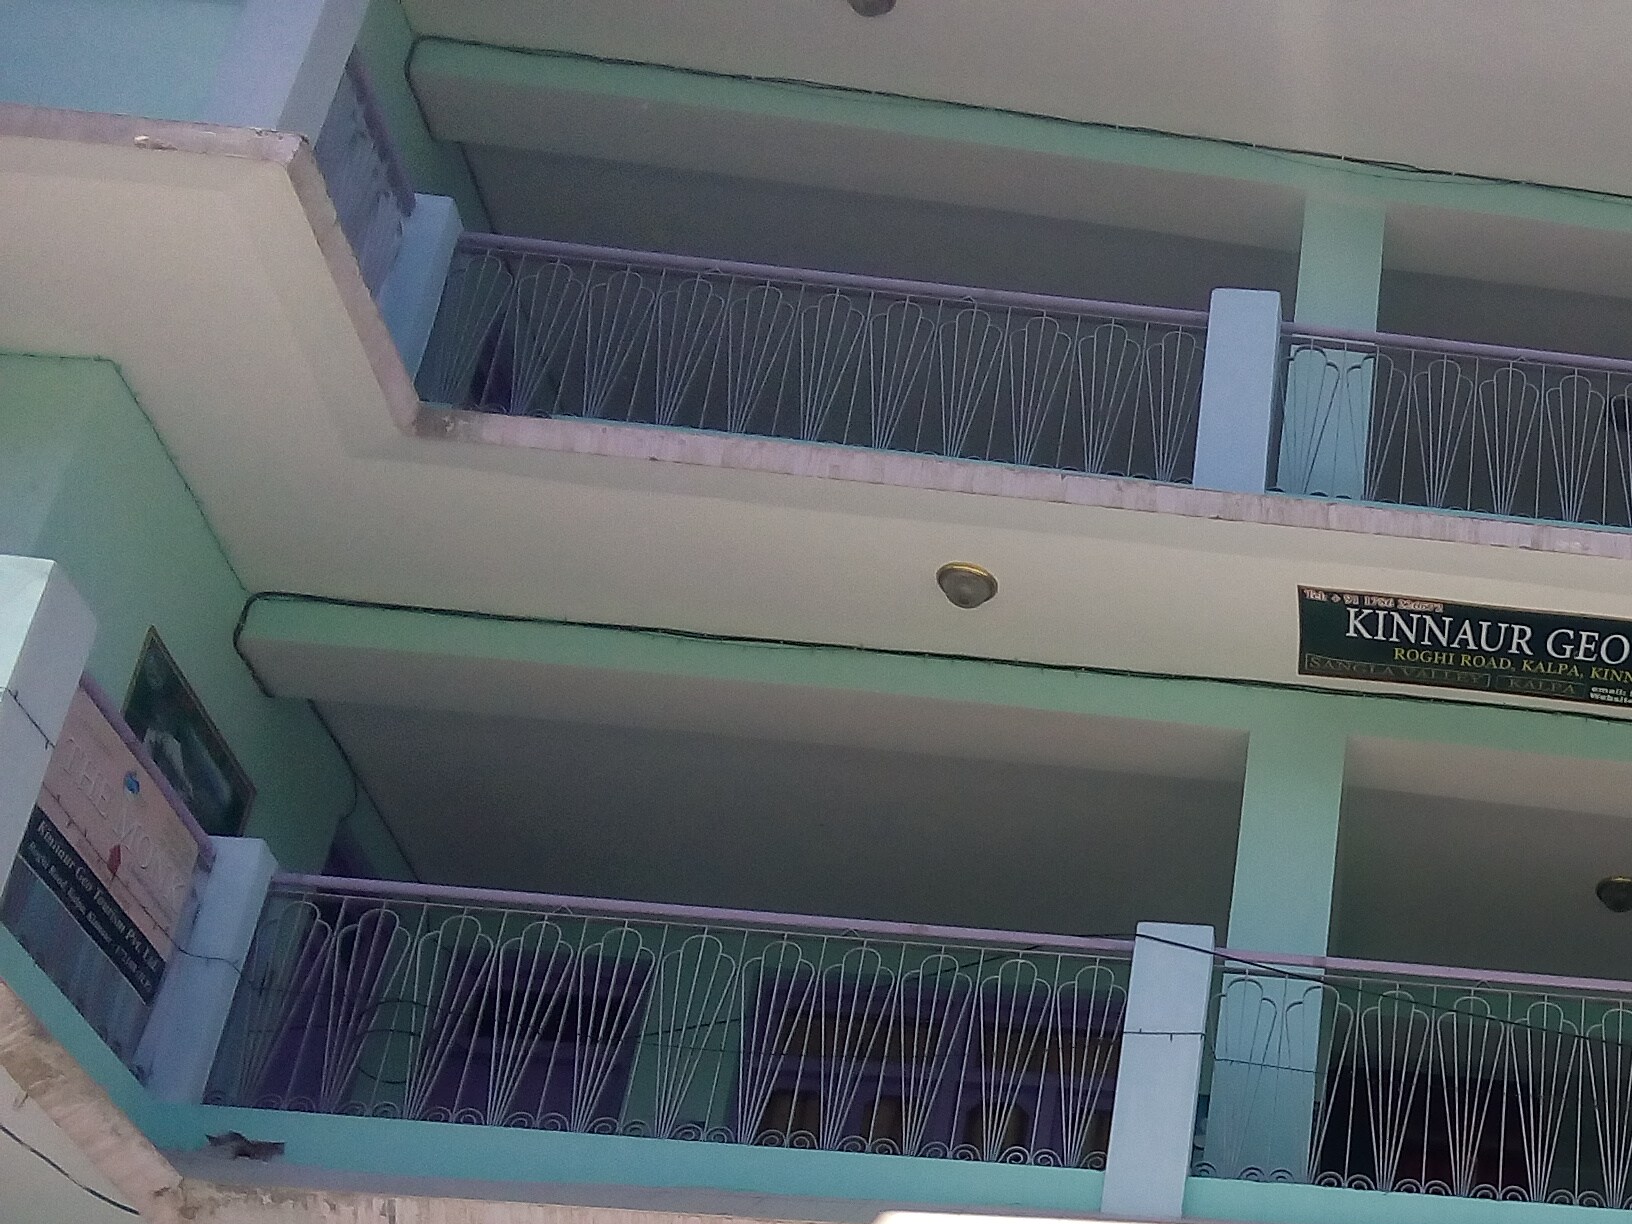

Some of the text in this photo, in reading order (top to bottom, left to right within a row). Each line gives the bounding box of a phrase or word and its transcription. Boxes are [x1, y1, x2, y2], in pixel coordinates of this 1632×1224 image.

[1346, 607, 1534, 656] KINNAUR
[1546, 628, 1631, 665] GEO
[1393, 647, 1456, 666] ROGHI
[1460, 653, 1516, 672] ROAD,
[1521, 659, 1584, 679] KALPA,
[1510, 678, 1576, 695] KALPA
